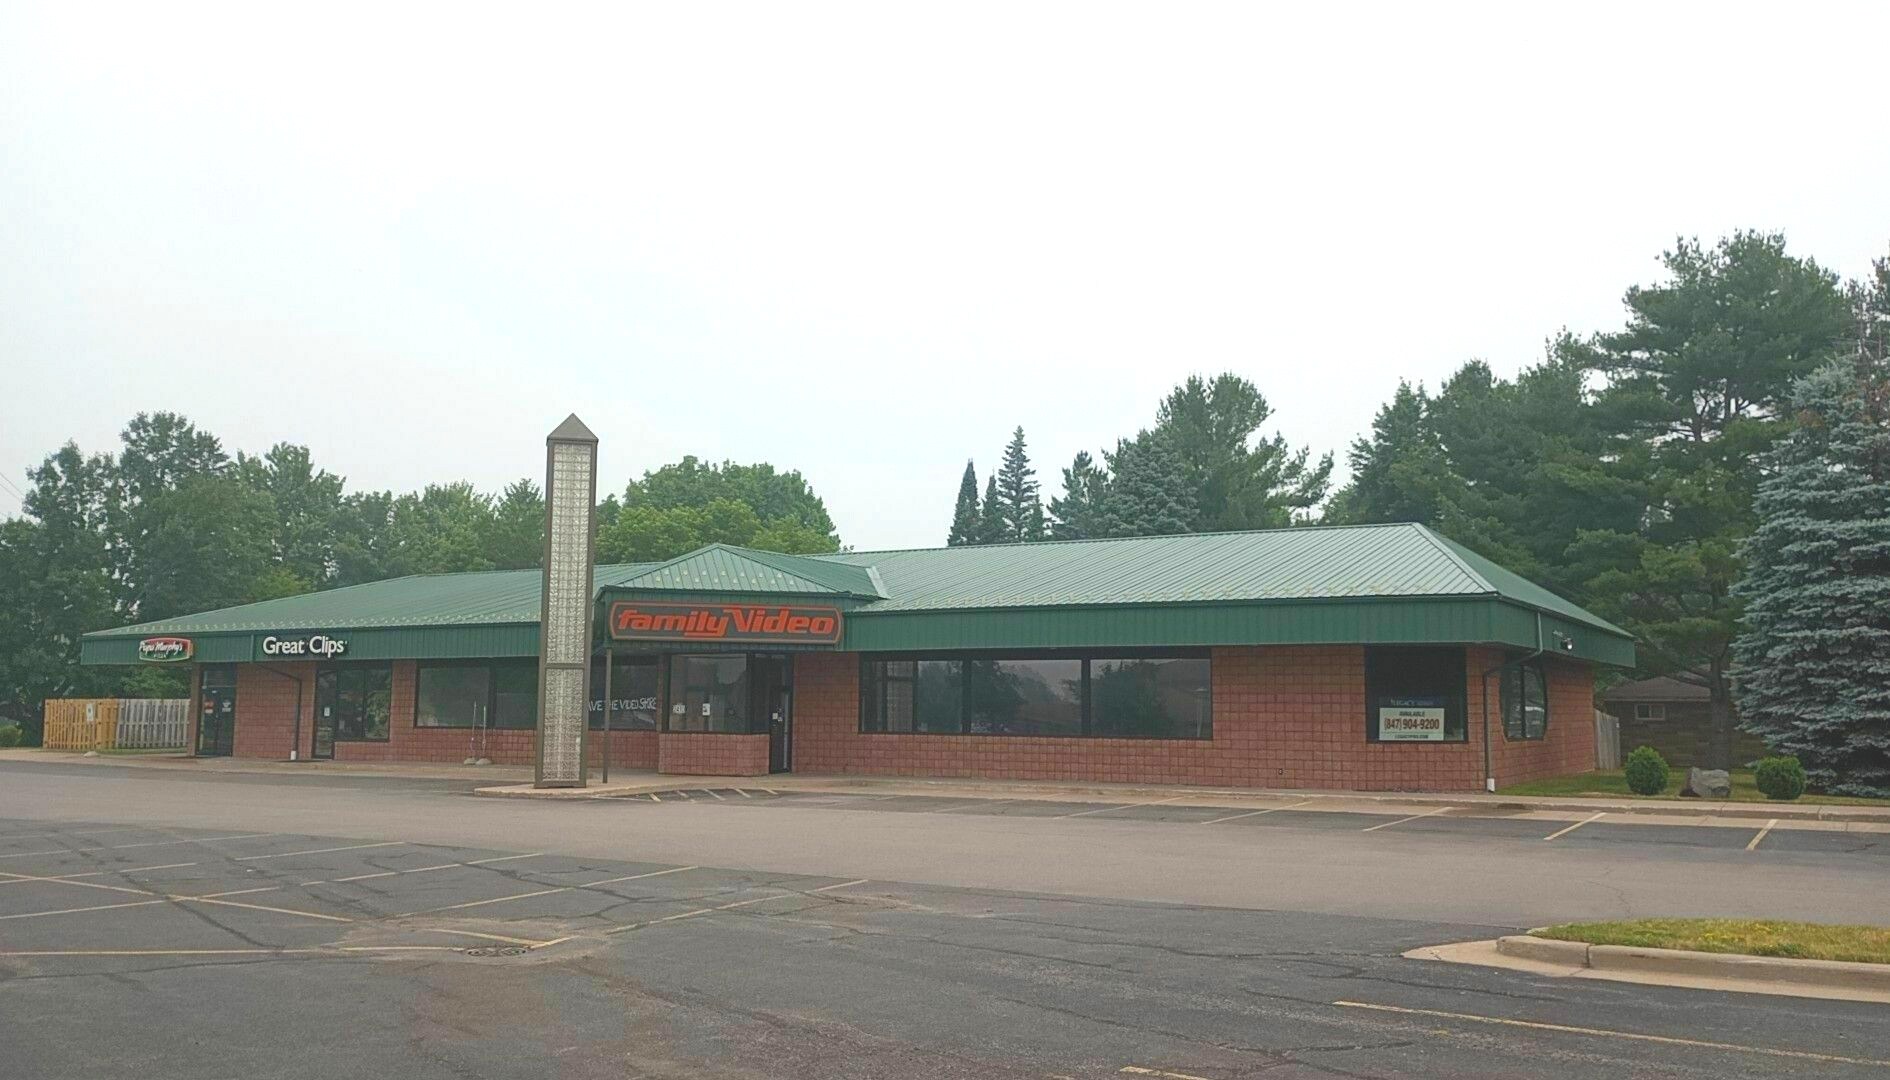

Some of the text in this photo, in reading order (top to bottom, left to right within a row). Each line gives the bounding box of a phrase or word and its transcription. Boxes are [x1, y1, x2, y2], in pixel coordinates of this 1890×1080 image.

[723, 606, 834, 634] Video
[263, 635, 344, 658] Great Clips
[587, 700, 604, 712] AVE
[1384, 718, 1440, 730] (847) 904-9200
